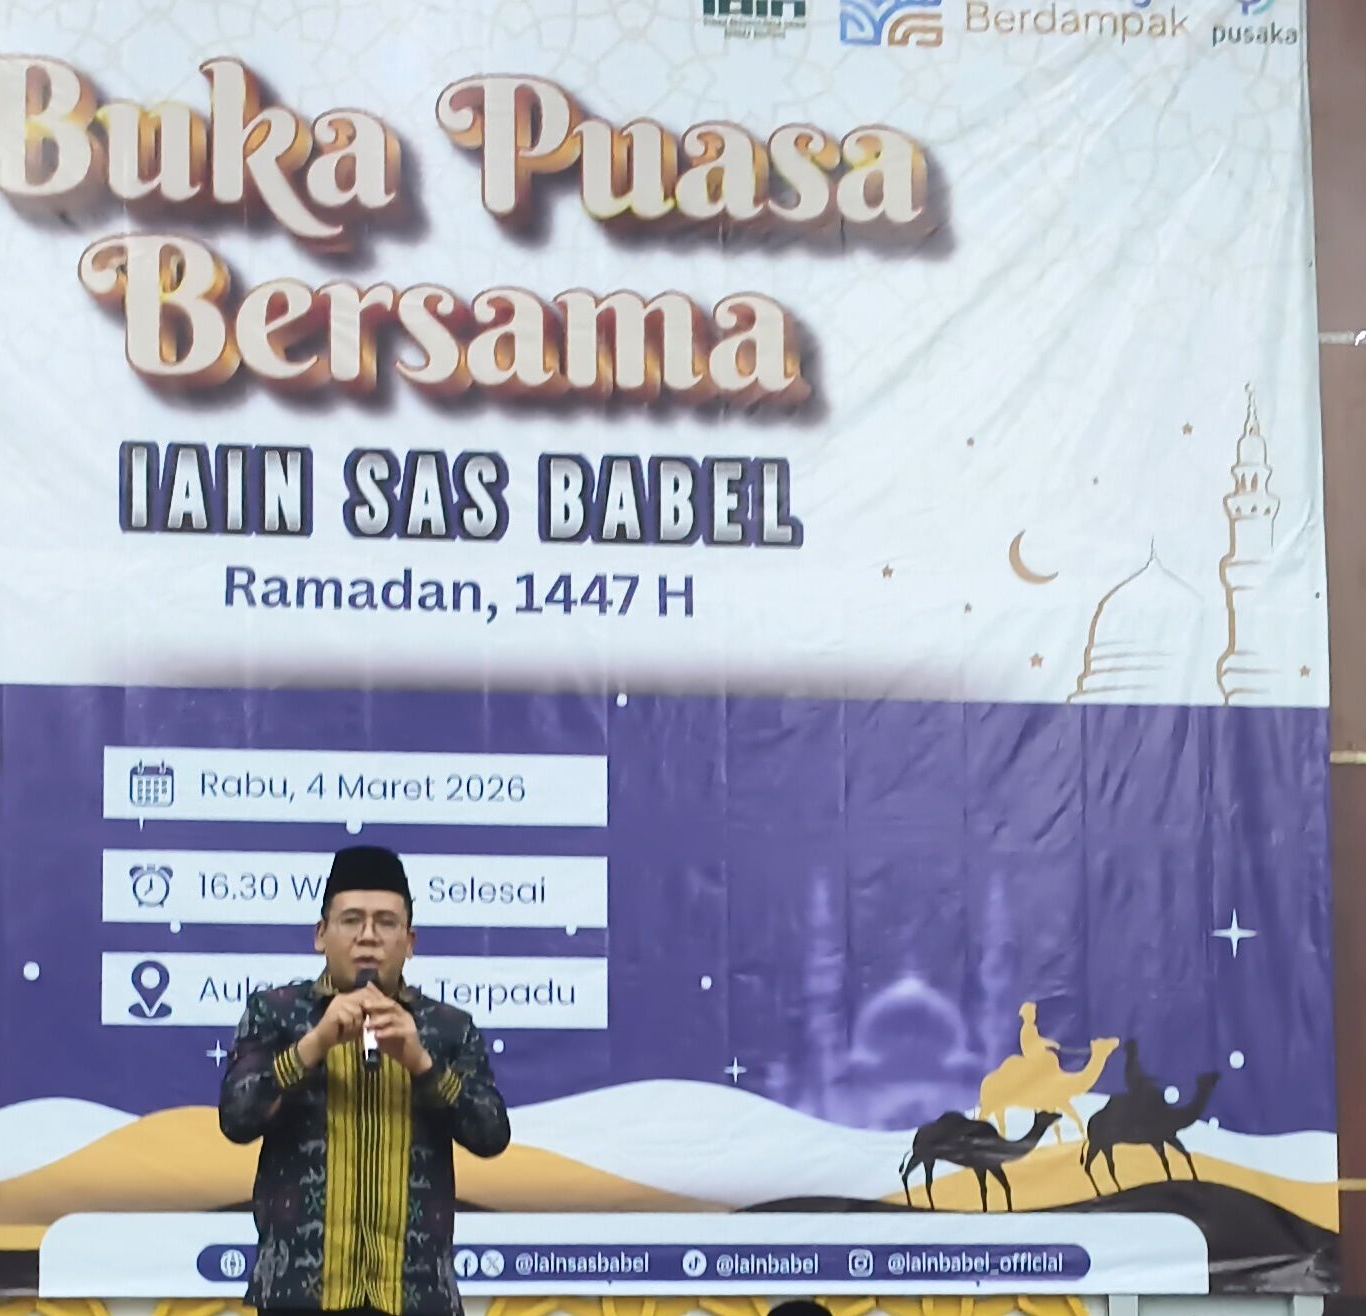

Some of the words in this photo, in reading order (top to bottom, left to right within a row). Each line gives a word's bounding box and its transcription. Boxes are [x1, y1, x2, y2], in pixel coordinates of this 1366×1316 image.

[966, 0, 1188, 45] Berdampak
[1211, 21, 1298, 48] pusaka
[436, 70, 937, 242] Puasa
[78, 230, 813, 408] Bersama
[119, 441, 314, 538] IAIN
[342, 447, 510, 542] SAS
[537, 452, 804, 548] BABEL
[224, 565, 498, 623] Ramadan,
[515, 573, 639, 616] 1447
[658, 576, 695, 618] H
[201, 771, 295, 803] Rabu,
[306, 773, 324, 799] 4
[338, 774, 436, 801] Maret
[446, 775, 527, 803] 2026
[198, 872, 279, 901] 16.30
[428, 876, 546, 904] Selesai
[436, 978, 575, 1013] Terpadu
